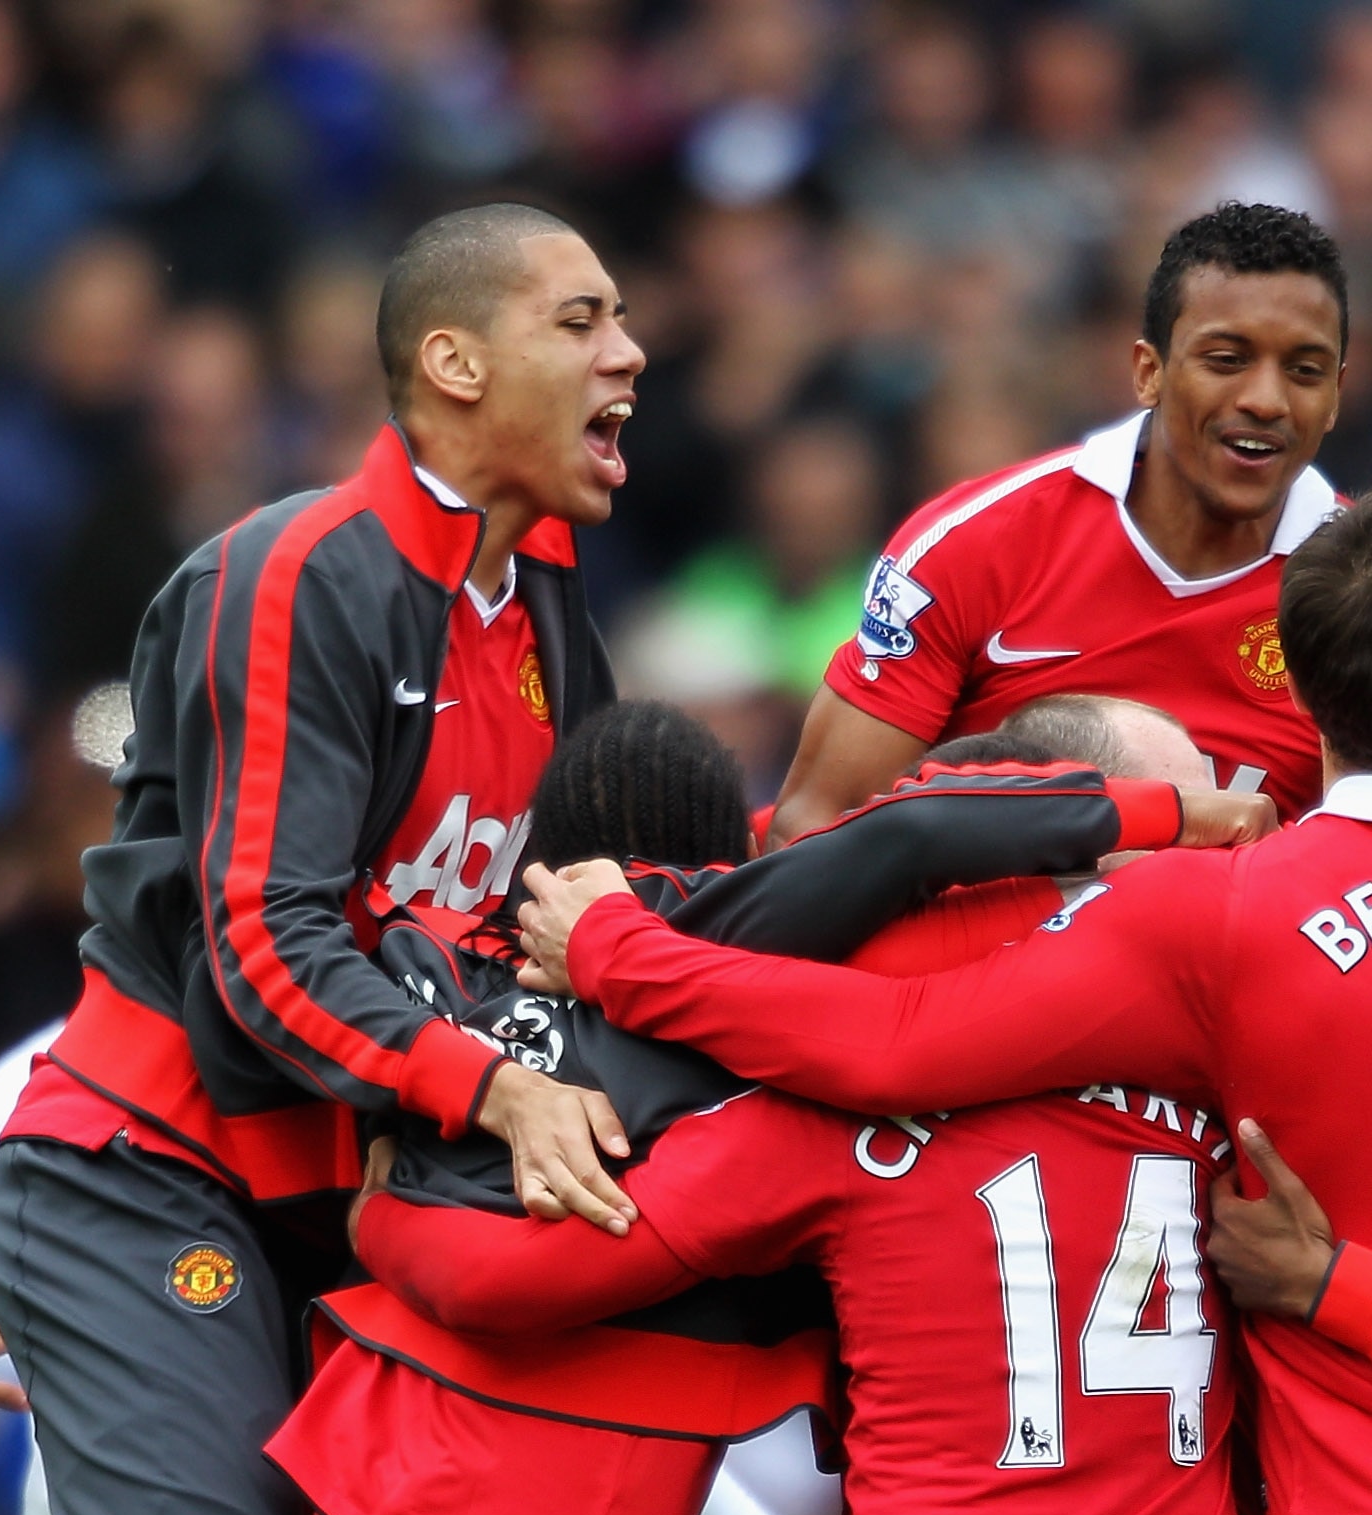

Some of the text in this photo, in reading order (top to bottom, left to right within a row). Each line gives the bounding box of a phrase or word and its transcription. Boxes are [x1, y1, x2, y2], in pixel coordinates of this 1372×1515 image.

[180, 1253, 229, 1272] MANCHESTER
[185, 1290, 221, 1301] UNITED
[974, 1151, 1218, 1469] 14
